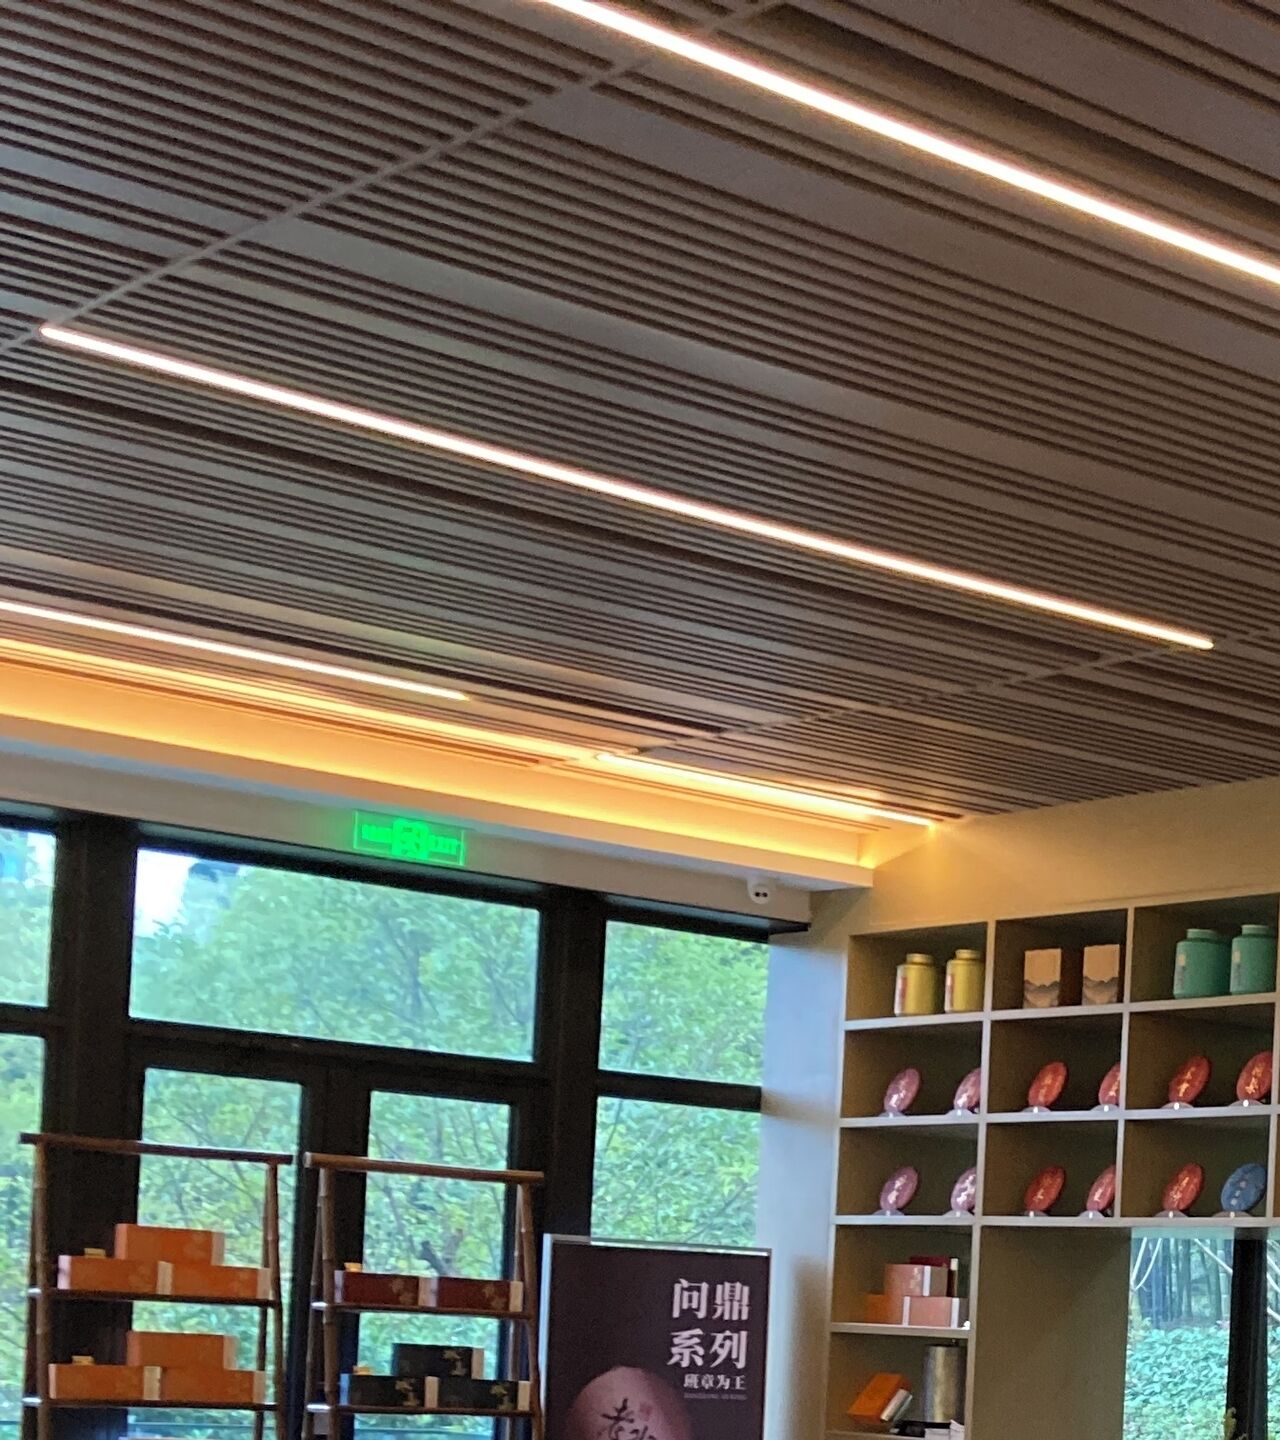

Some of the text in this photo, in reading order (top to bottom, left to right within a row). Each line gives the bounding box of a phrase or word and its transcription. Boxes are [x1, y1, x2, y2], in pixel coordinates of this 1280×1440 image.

[672, 1278, 749, 1320] 问鼎
[667, 1328, 748, 1369] 系列
[684, 1373, 747, 1390] 班章为王
